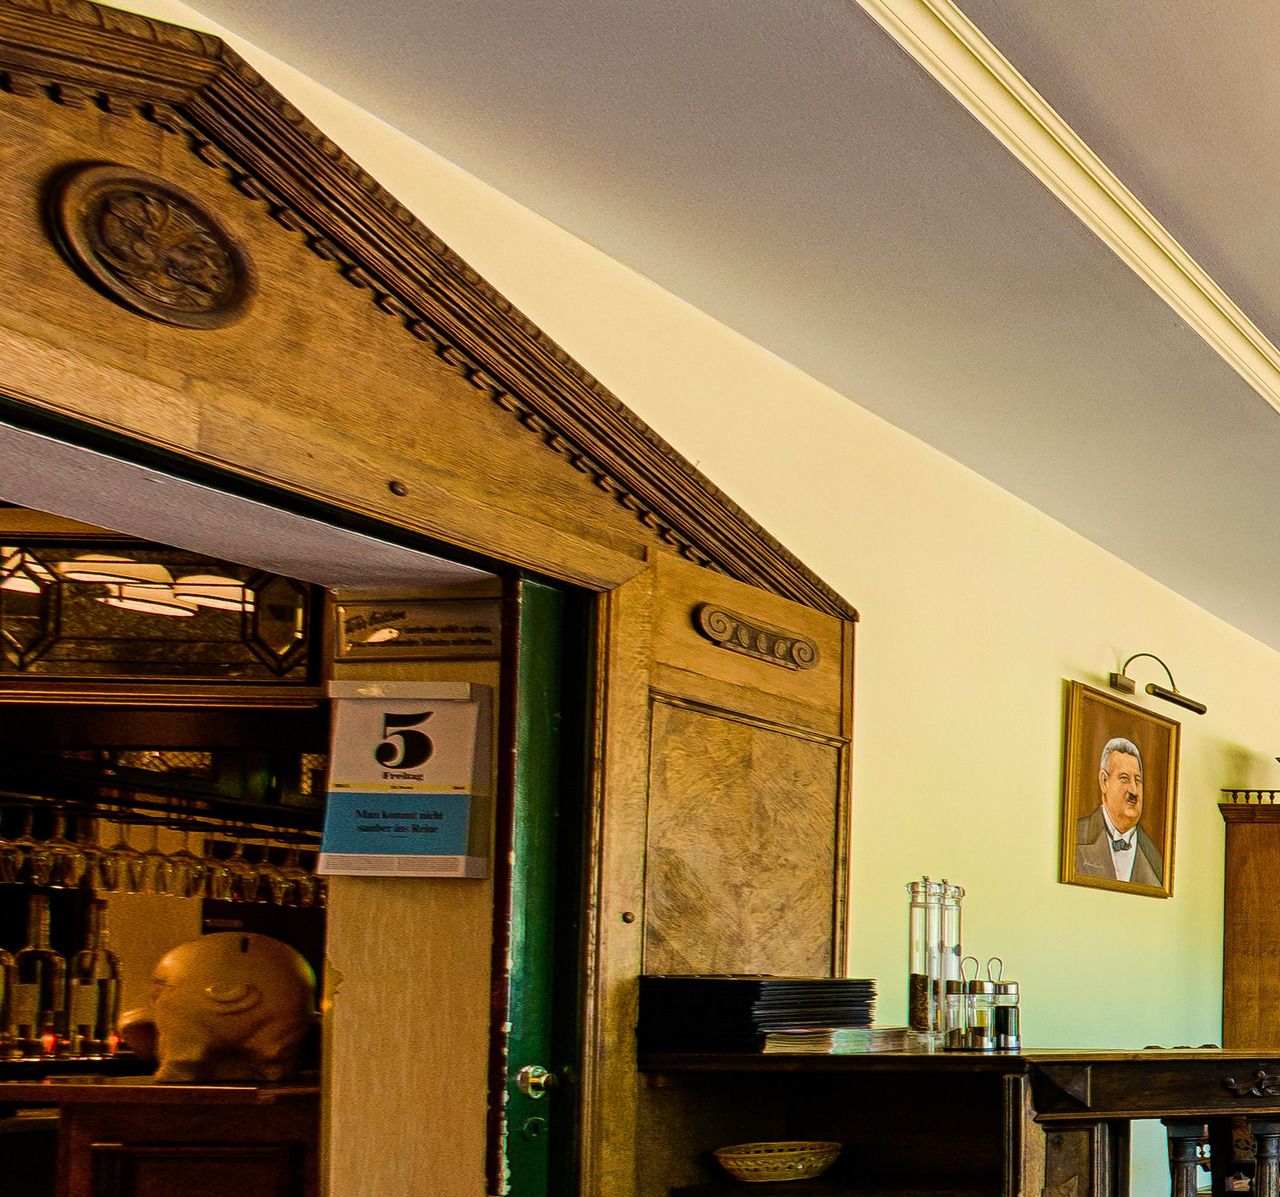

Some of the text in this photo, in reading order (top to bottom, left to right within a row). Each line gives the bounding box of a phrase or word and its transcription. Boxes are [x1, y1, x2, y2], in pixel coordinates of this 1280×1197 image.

[375, 711, 434, 769] 5
[382, 771, 425, 782] Freitag
[355, 809, 444, 820] Man kommt nicht
[357, 823, 439, 833] sauber ins Reine
